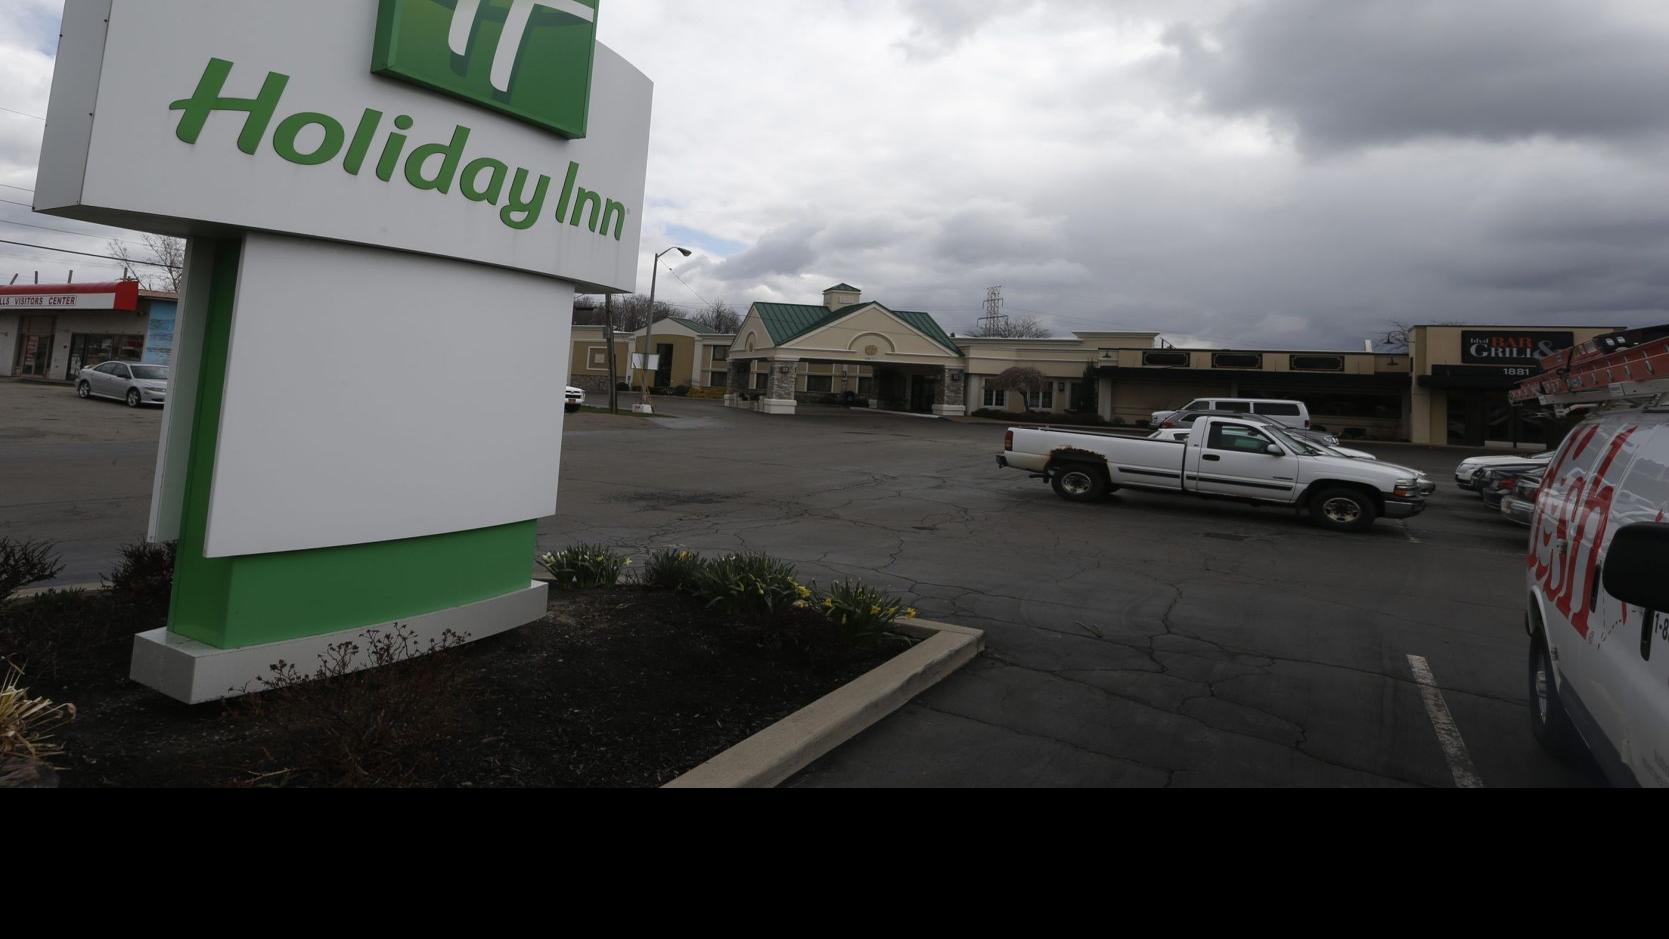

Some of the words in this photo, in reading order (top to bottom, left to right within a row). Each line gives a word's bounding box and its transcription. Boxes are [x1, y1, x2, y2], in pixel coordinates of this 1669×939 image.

[169, 57, 551, 230] Holiday
[555, 160, 627, 241] Inn
[15, 296, 43, 305] VISITORS
[48, 295, 76, 305] CENTER
[1490, 336, 1533, 348] BAR
[1503, 368, 1529, 376] 1881
